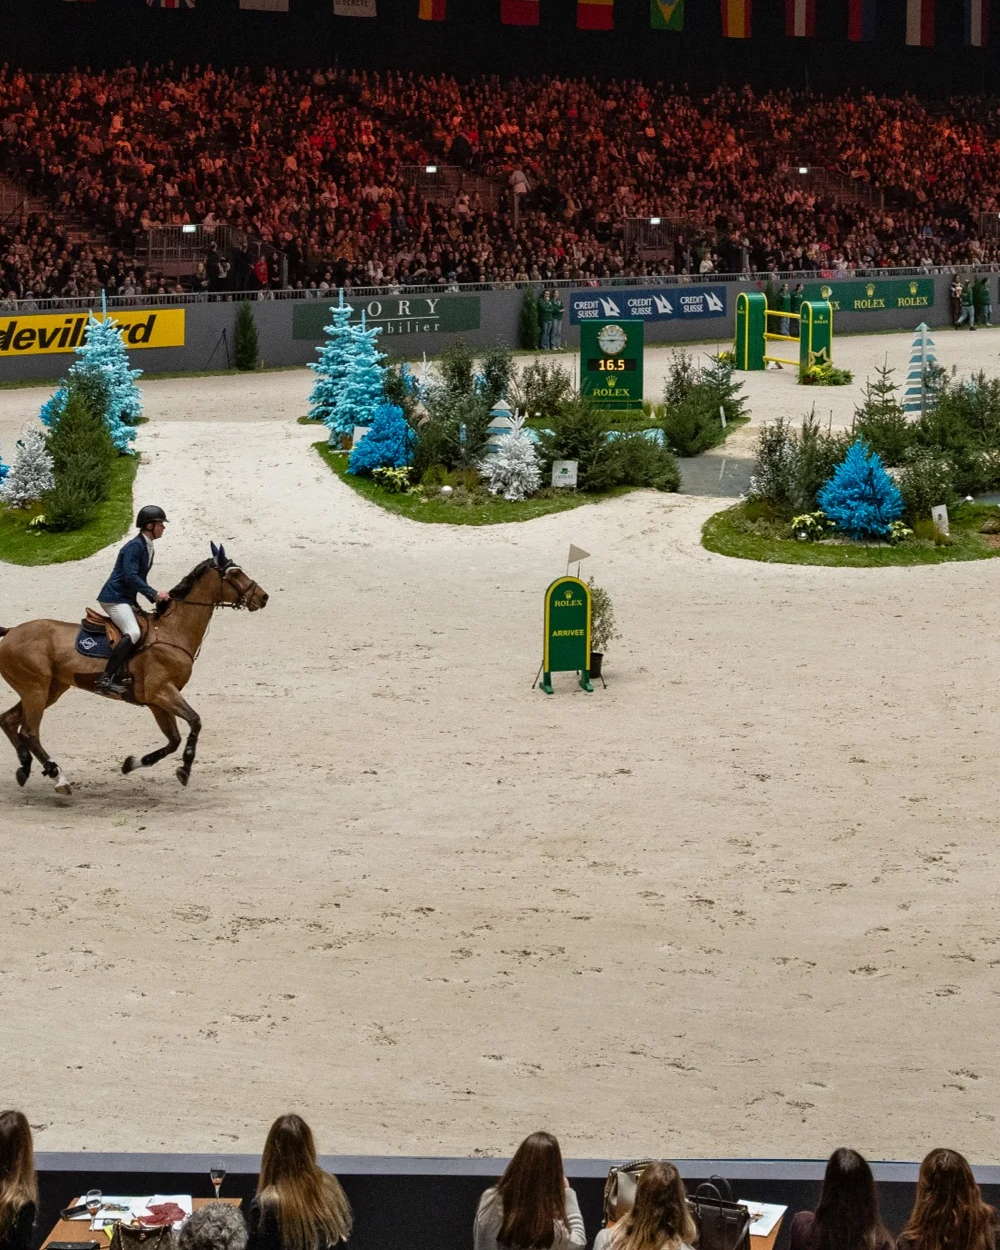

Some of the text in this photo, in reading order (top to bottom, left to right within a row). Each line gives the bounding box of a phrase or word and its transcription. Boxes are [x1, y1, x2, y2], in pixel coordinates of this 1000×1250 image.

[573, 300, 599, 310] CREDIT
[627, 298, 652, 308] CREDIT
[679, 295, 704, 305] CREDIT
[854, 298, 886, 310] ROLEX
[898, 296, 929, 307] ROLEX
[631, 306, 652, 316] SUISSE
[683, 303, 704, 314] SUISSE
[577, 309, 599, 319] SUISSE
[598, 359, 626, 371] 16.5
[592, 388, 631, 397] ROLEX
[554, 599, 583, 607] ROLEX
[552, 629, 585, 638] ARRIVEE
